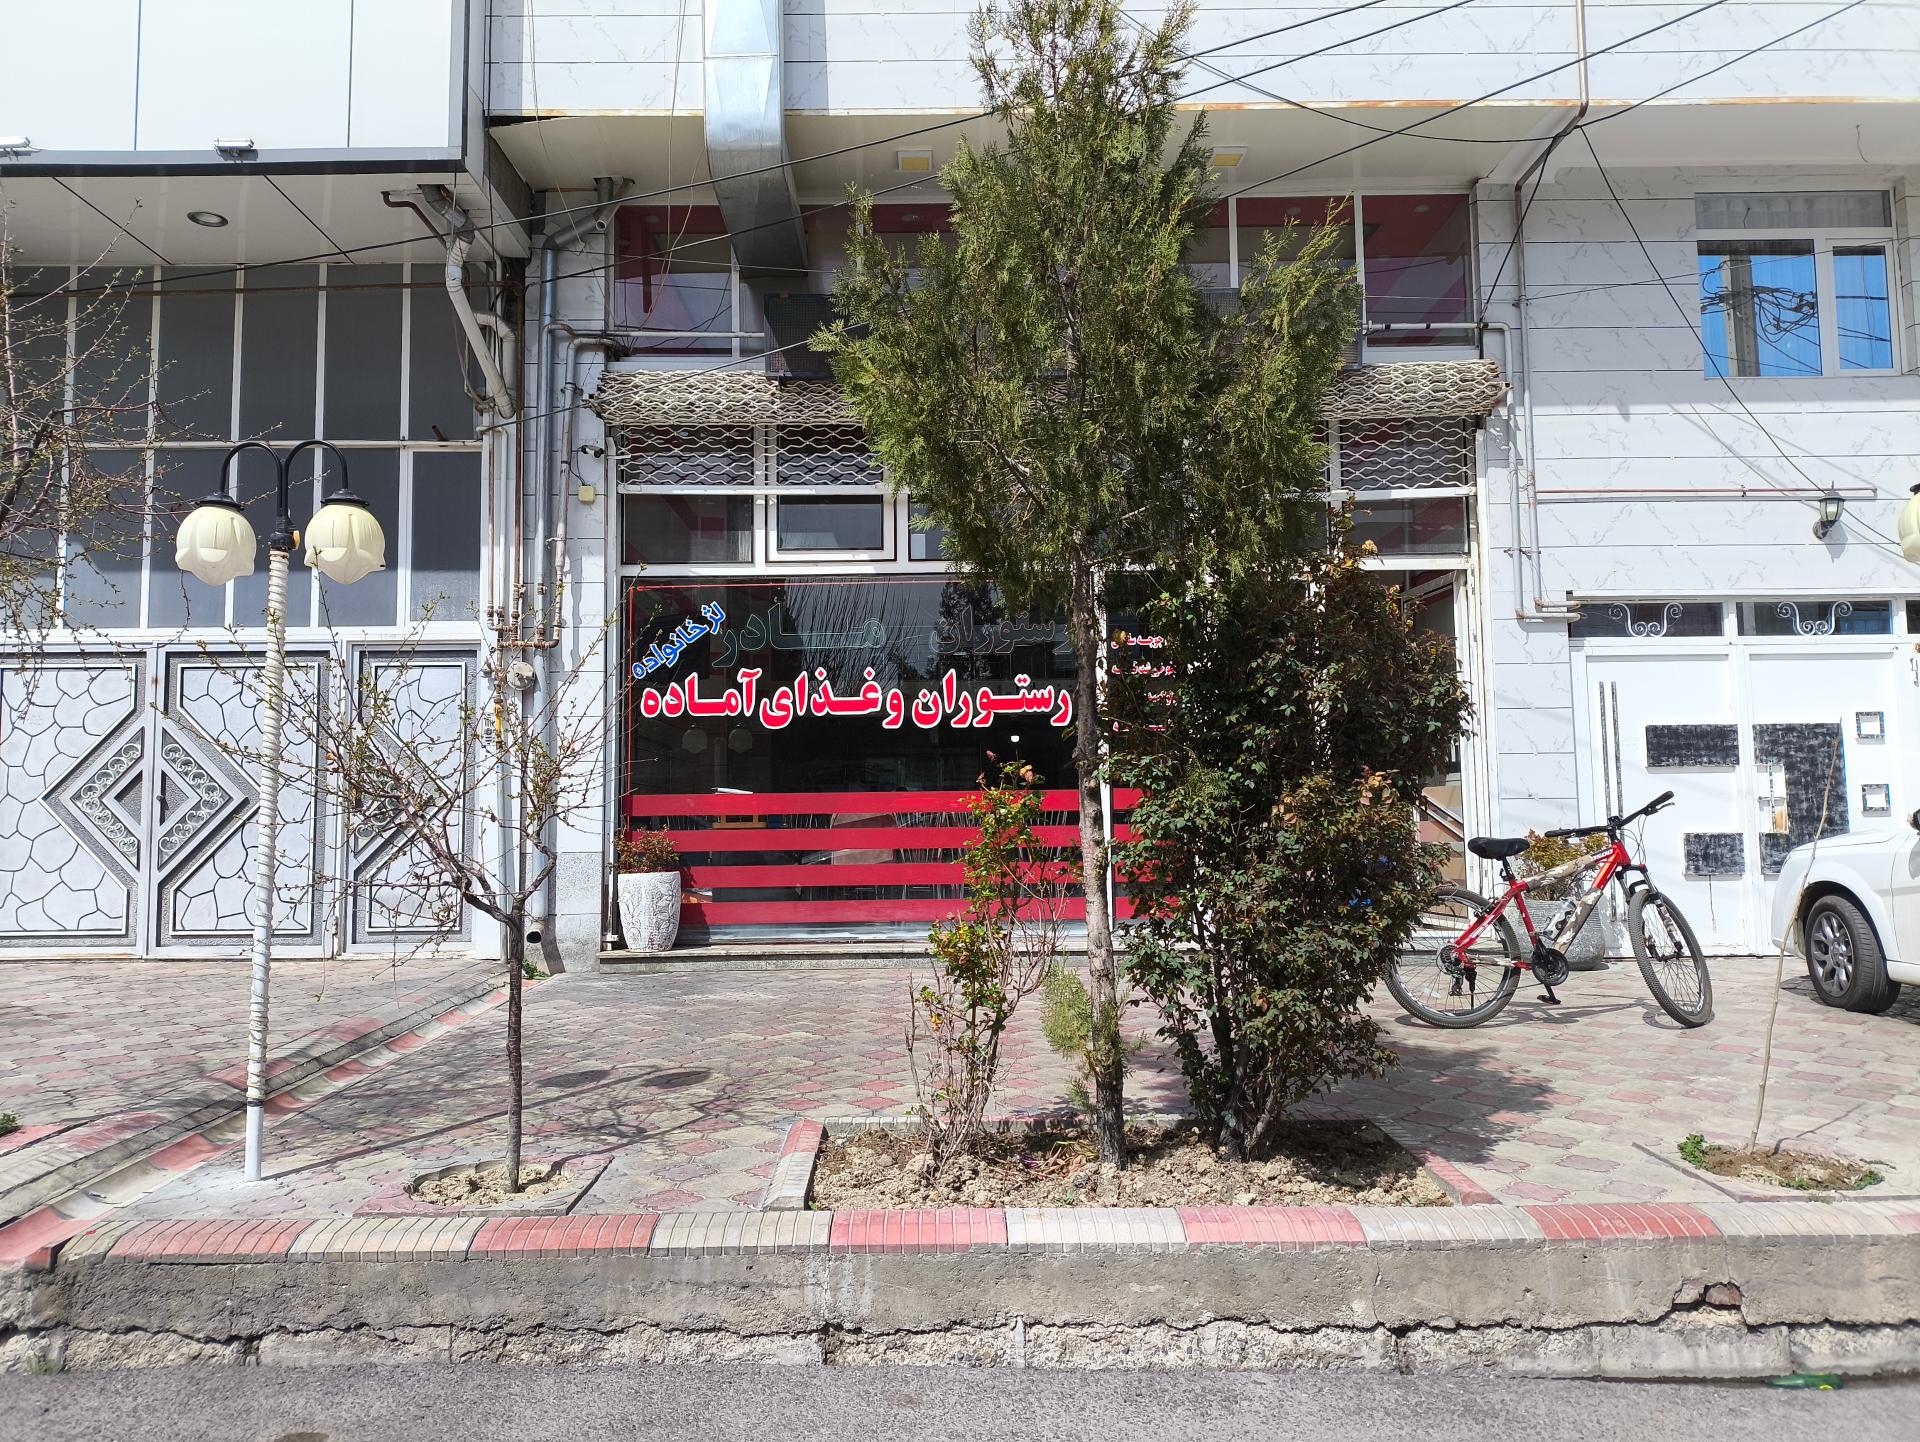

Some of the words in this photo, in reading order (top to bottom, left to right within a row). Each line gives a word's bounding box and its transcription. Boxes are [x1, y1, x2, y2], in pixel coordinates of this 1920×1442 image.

[632, 618, 710, 680] خانواده
[711, 602, 886, 668] مادر
[928, 604, 1073, 655] رستوران
[640, 667, 763, 718] آماده
[911, 667, 1073, 729] رستوران
